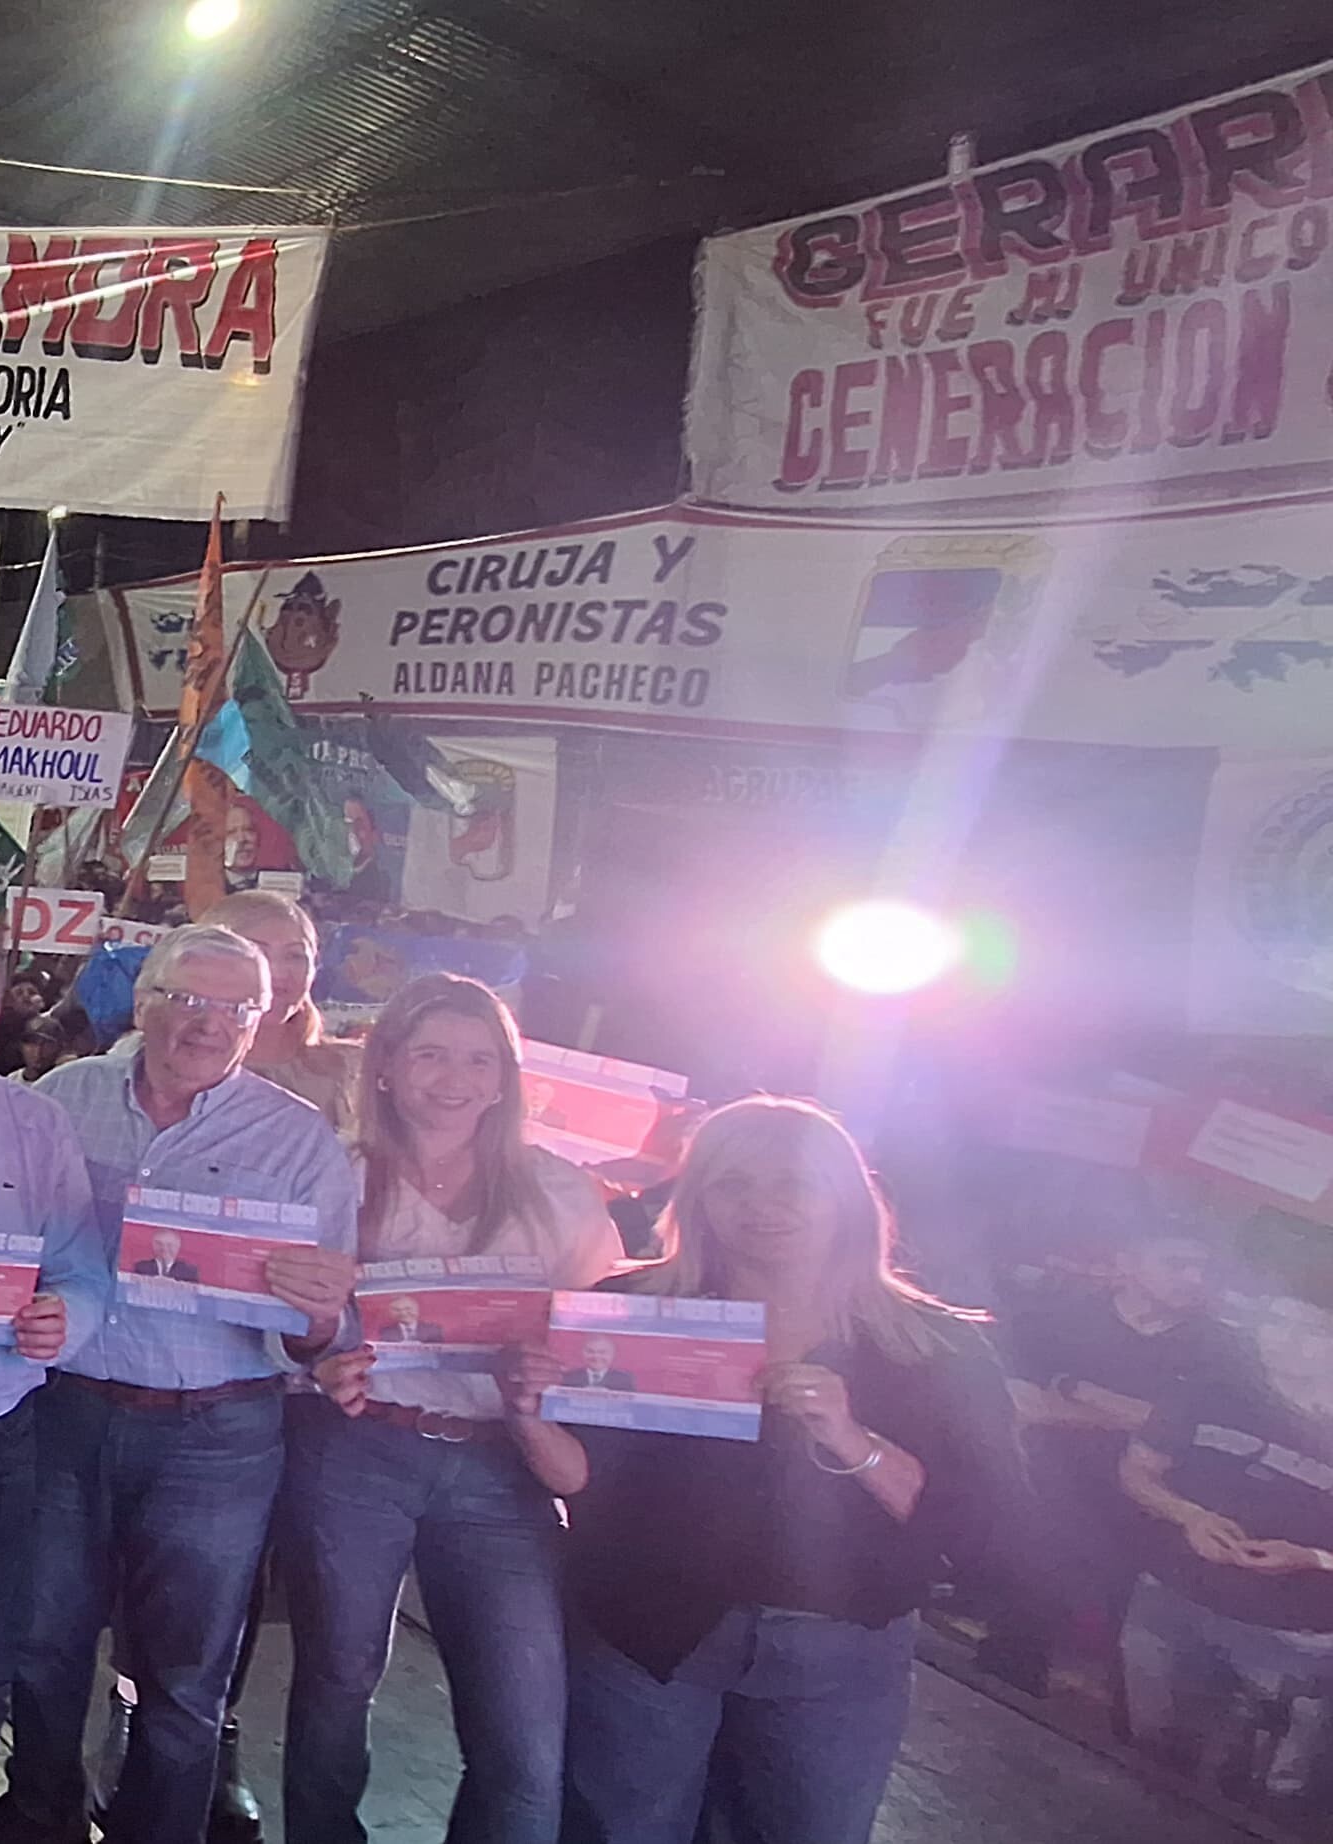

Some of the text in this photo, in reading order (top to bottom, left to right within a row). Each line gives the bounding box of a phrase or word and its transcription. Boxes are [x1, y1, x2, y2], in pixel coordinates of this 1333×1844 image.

[866, 284, 985, 350] FUE
[426, 533, 696, 597] CIRUJA Y
[388, 600, 729, 649] PERONISTAS
[393, 660, 711, 707] ALDANA PACHECO
[11, 896, 97, 946] DZ
